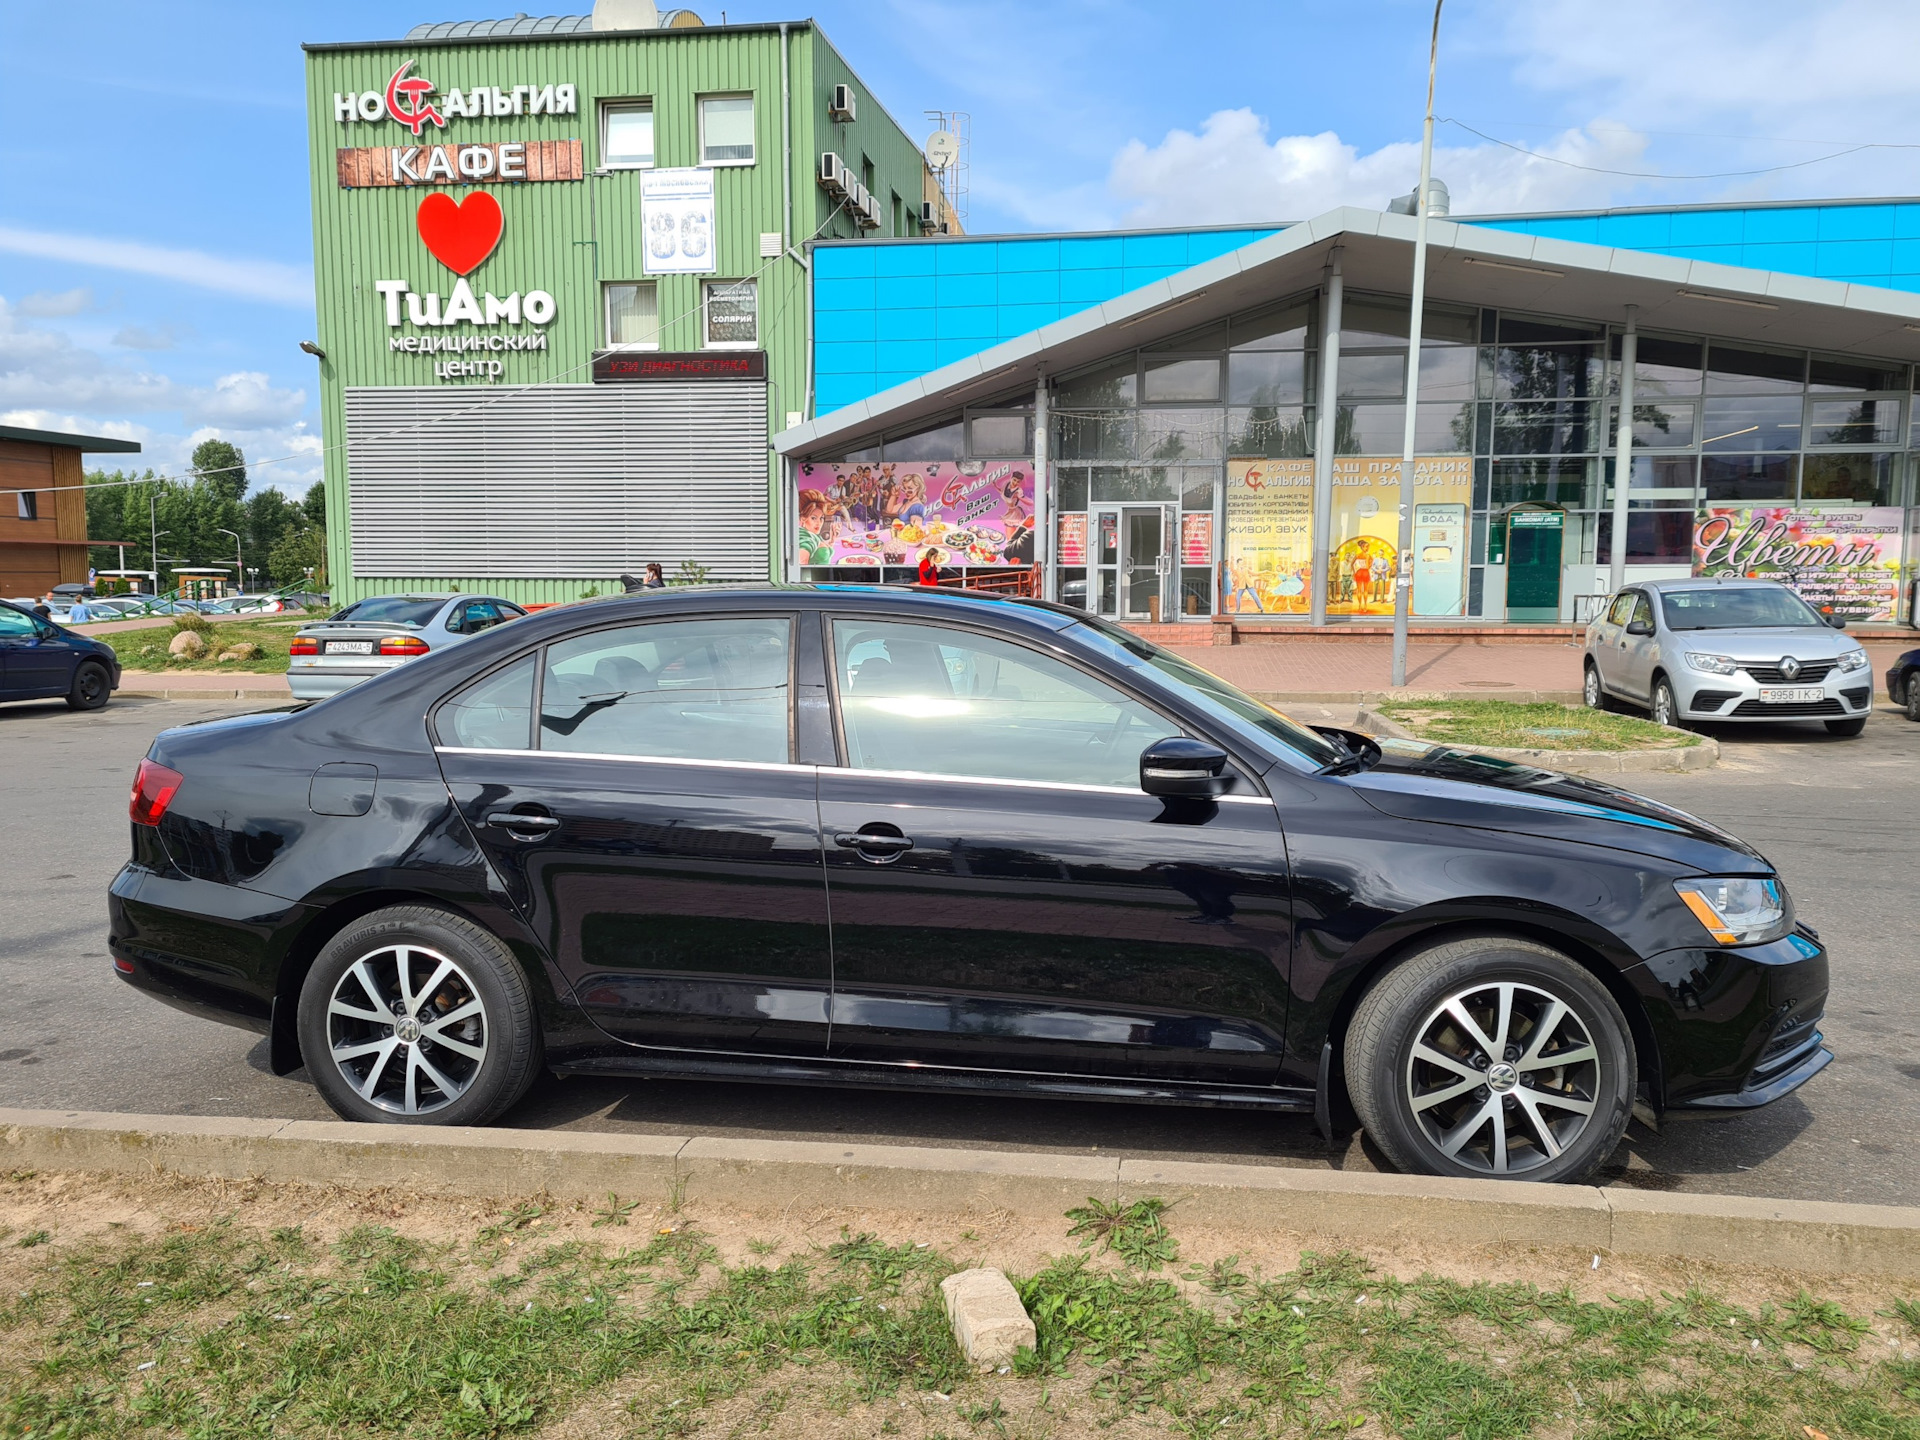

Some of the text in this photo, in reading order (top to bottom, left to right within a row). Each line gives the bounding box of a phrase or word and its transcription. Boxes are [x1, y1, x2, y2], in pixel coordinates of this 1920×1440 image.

[391, 143, 527, 182] КАФЕ
[650, 211, 706, 259] 86
[375, 278, 556, 327] ТиАмо
[712, 314, 753, 323] СОЛЯРИЙ
[389, 329, 547, 354] медицинский
[434, 359, 503, 382] центр
[609, 359, 748, 374] УЗИ ДИАГНОСТИКА
[1266, 463, 1312, 472] КАФЕ
[1332, 462, 1469, 474] АШ ПРАДНИК
[1332, 475, 1372, 486] АША
[1378, 475, 1444, 486] ЗАОТА
[966, 493, 991, 512] Ваш
[1422, 515, 1453, 523] ВОДА
[1228, 525, 1307, 533] ЖИВОЙ ЗВУК
[1695, 516, 1877, 573] Цветы
[1770, 690, 1794, 700] 9958
